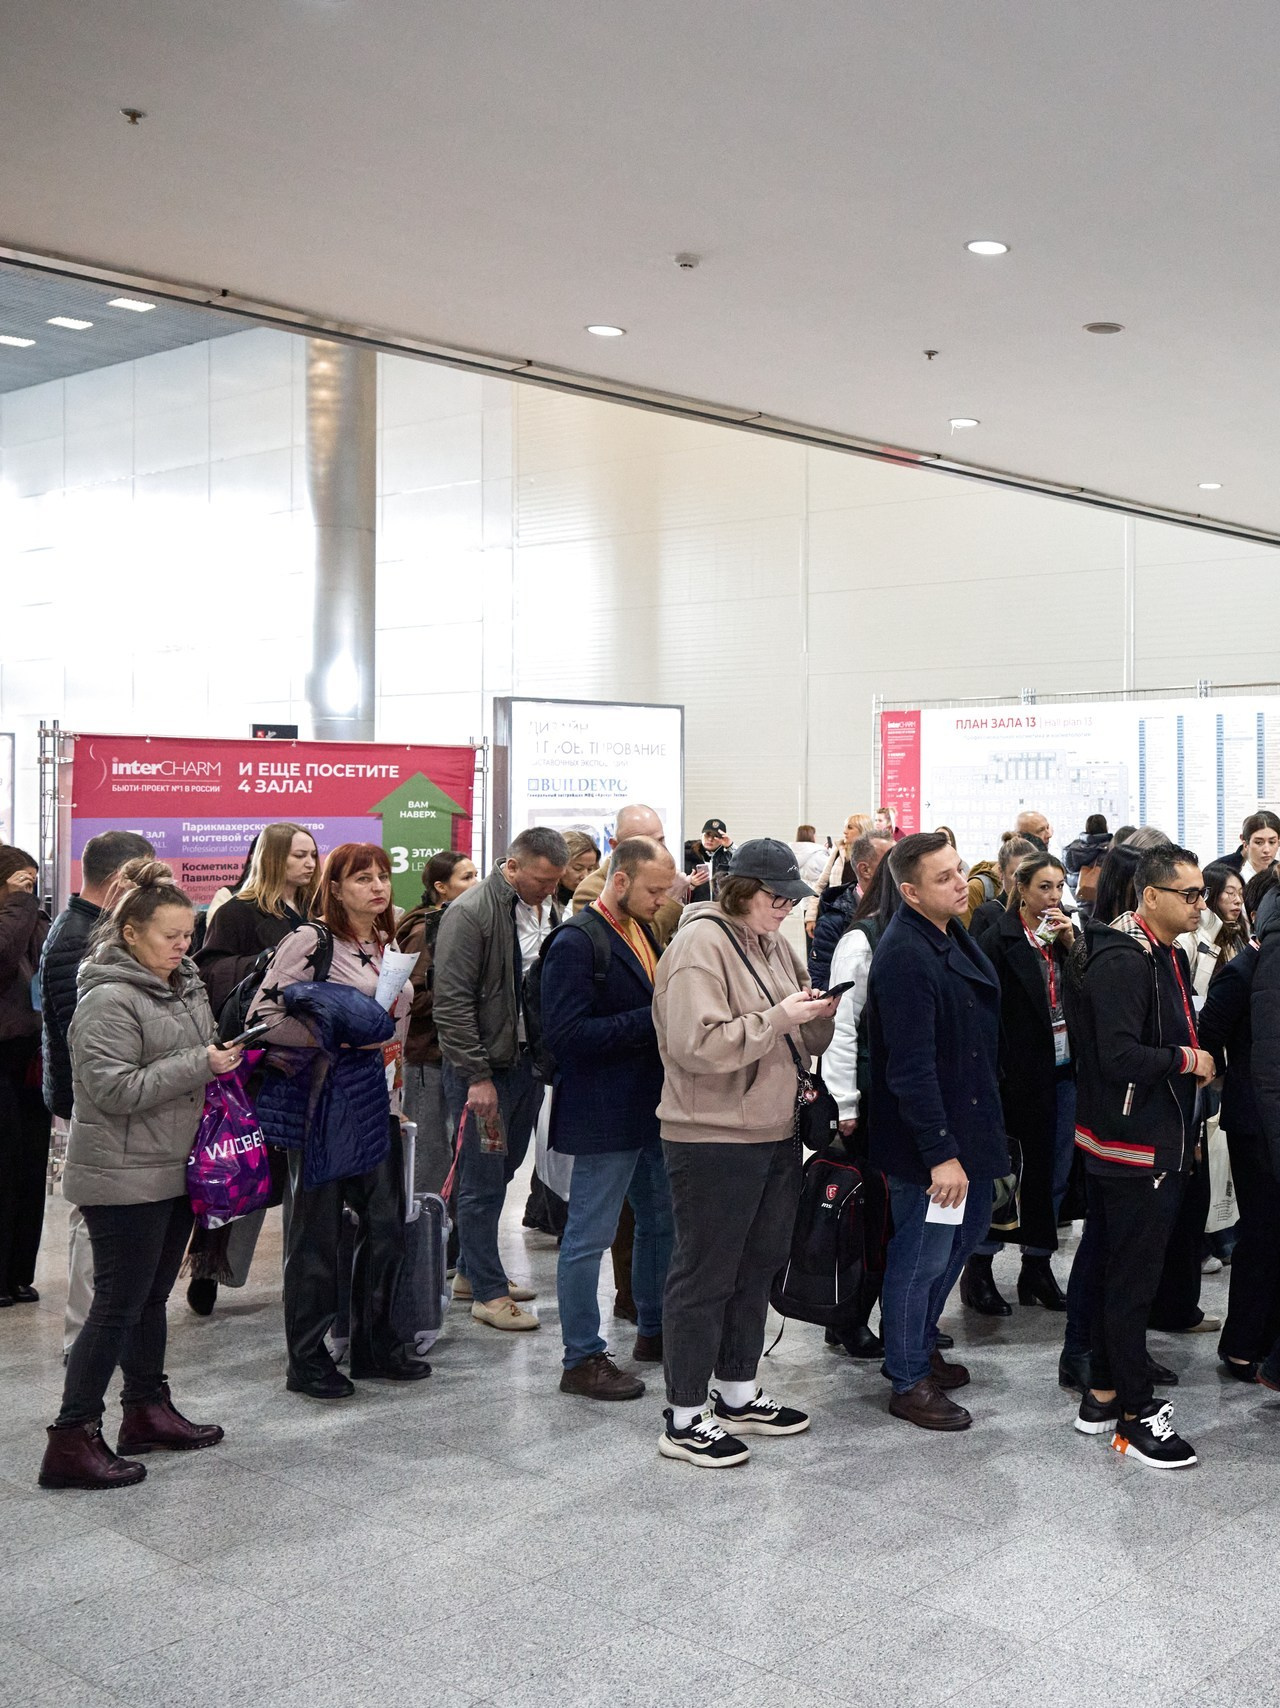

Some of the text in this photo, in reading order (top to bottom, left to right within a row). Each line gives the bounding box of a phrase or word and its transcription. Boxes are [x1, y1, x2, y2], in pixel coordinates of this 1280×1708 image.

[956, 718, 988, 730] ПЛАН
[991, 717, 1023, 729] ЗАЛА
[1025, 716, 1037, 728] 13
[112, 756, 221, 776] interCHARM
[238, 762, 399, 779] И ЕЩЕ ПОСЕТИТЕ
[112, 784, 170, 792] БЬЮТИ-ПРОЕКТ
[238, 779, 313, 793] 4 ЗАЛА!
[408, 800, 429, 809] ВАМ
[400, 810, 436, 819] НАВЕРХ
[182, 822, 267, 833] Парикмахерско
[146, 831, 165, 839] ЗАЛ
[192, 833, 241, 842] ногтевой
[390, 846, 409, 874] 3
[182, 862, 239, 871] Косметика
